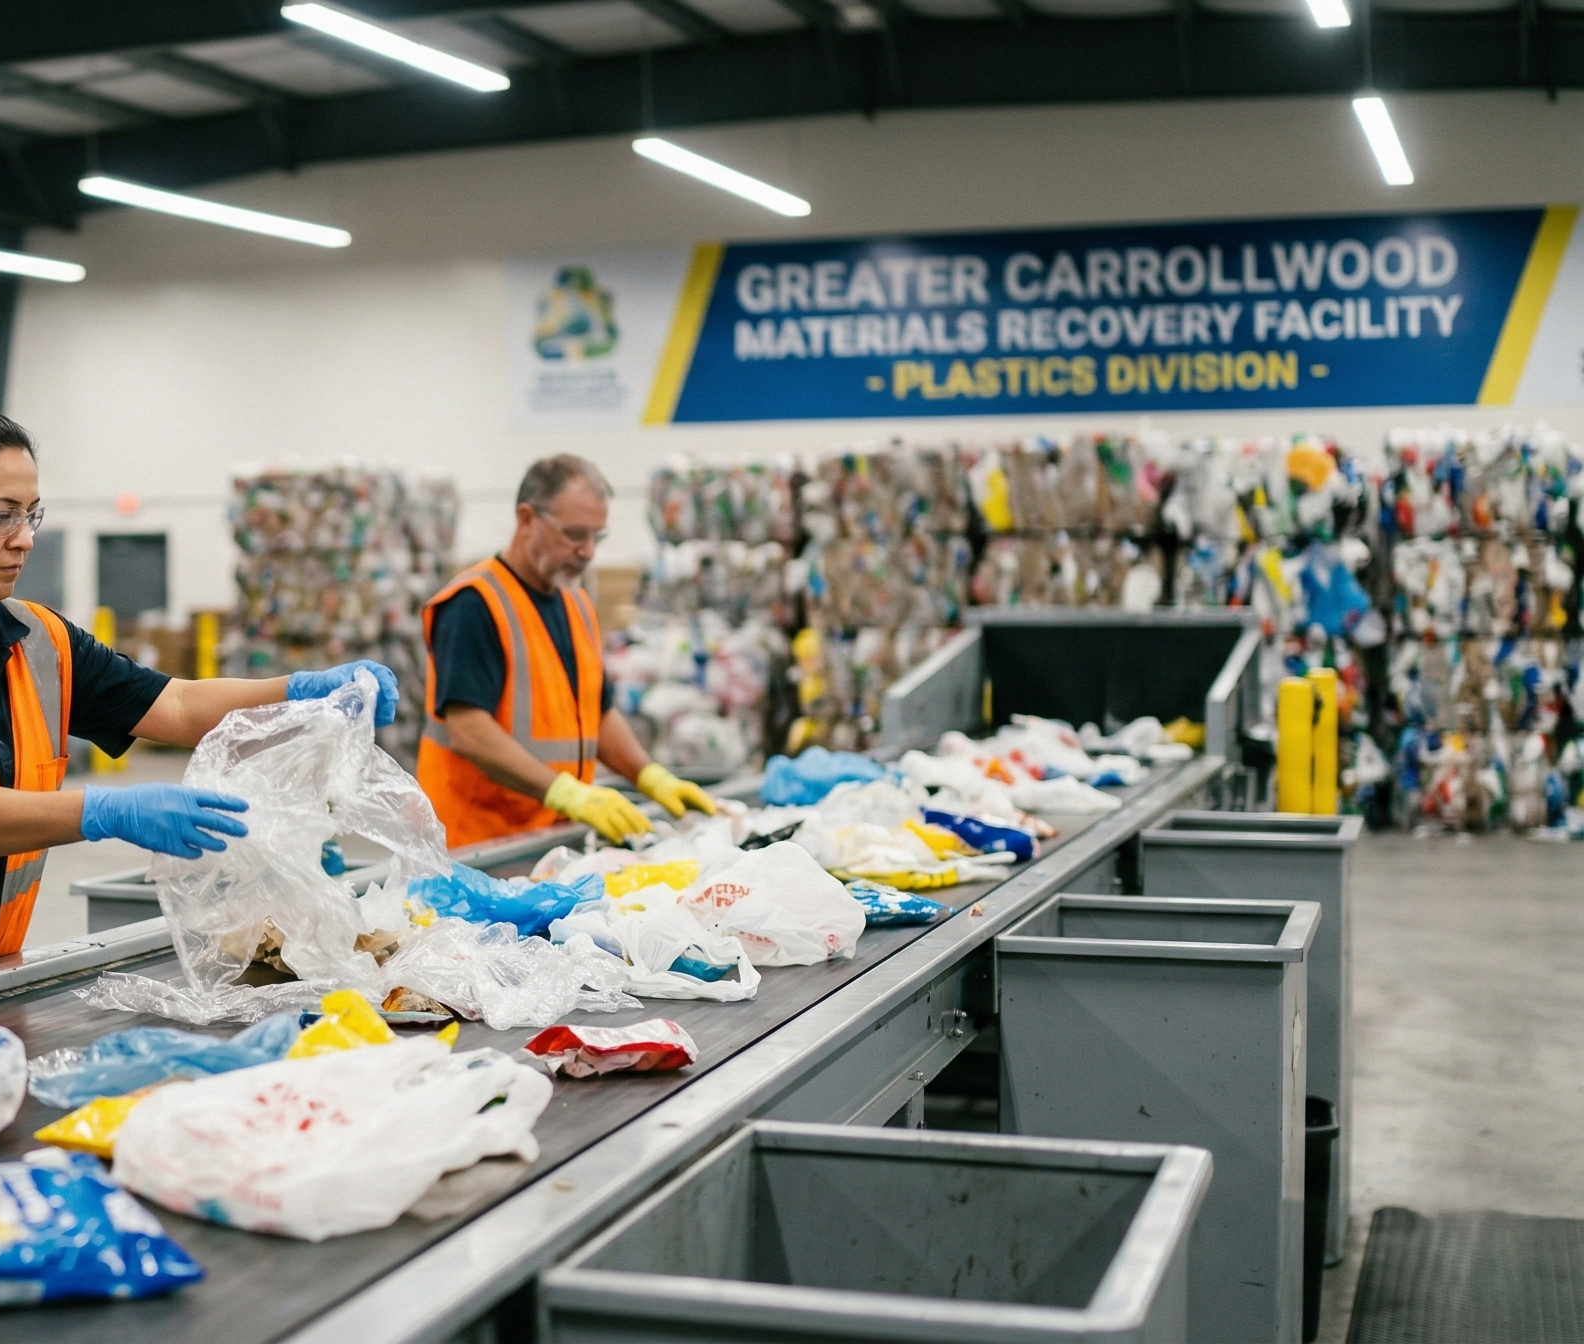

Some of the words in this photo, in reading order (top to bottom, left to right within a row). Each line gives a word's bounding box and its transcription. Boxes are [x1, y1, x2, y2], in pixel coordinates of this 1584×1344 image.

[735, 254, 990, 314] GREATER
[1002, 234, 1460, 301] CARROLLWOOD
[733, 310, 989, 361] MATERIALS
[996, 300, 1243, 351] RECOVERY
[1252, 293, 1465, 343] FACILITY
[891, 354, 1098, 401] PLASTICS
[1105, 349, 1299, 395] DIVISION
